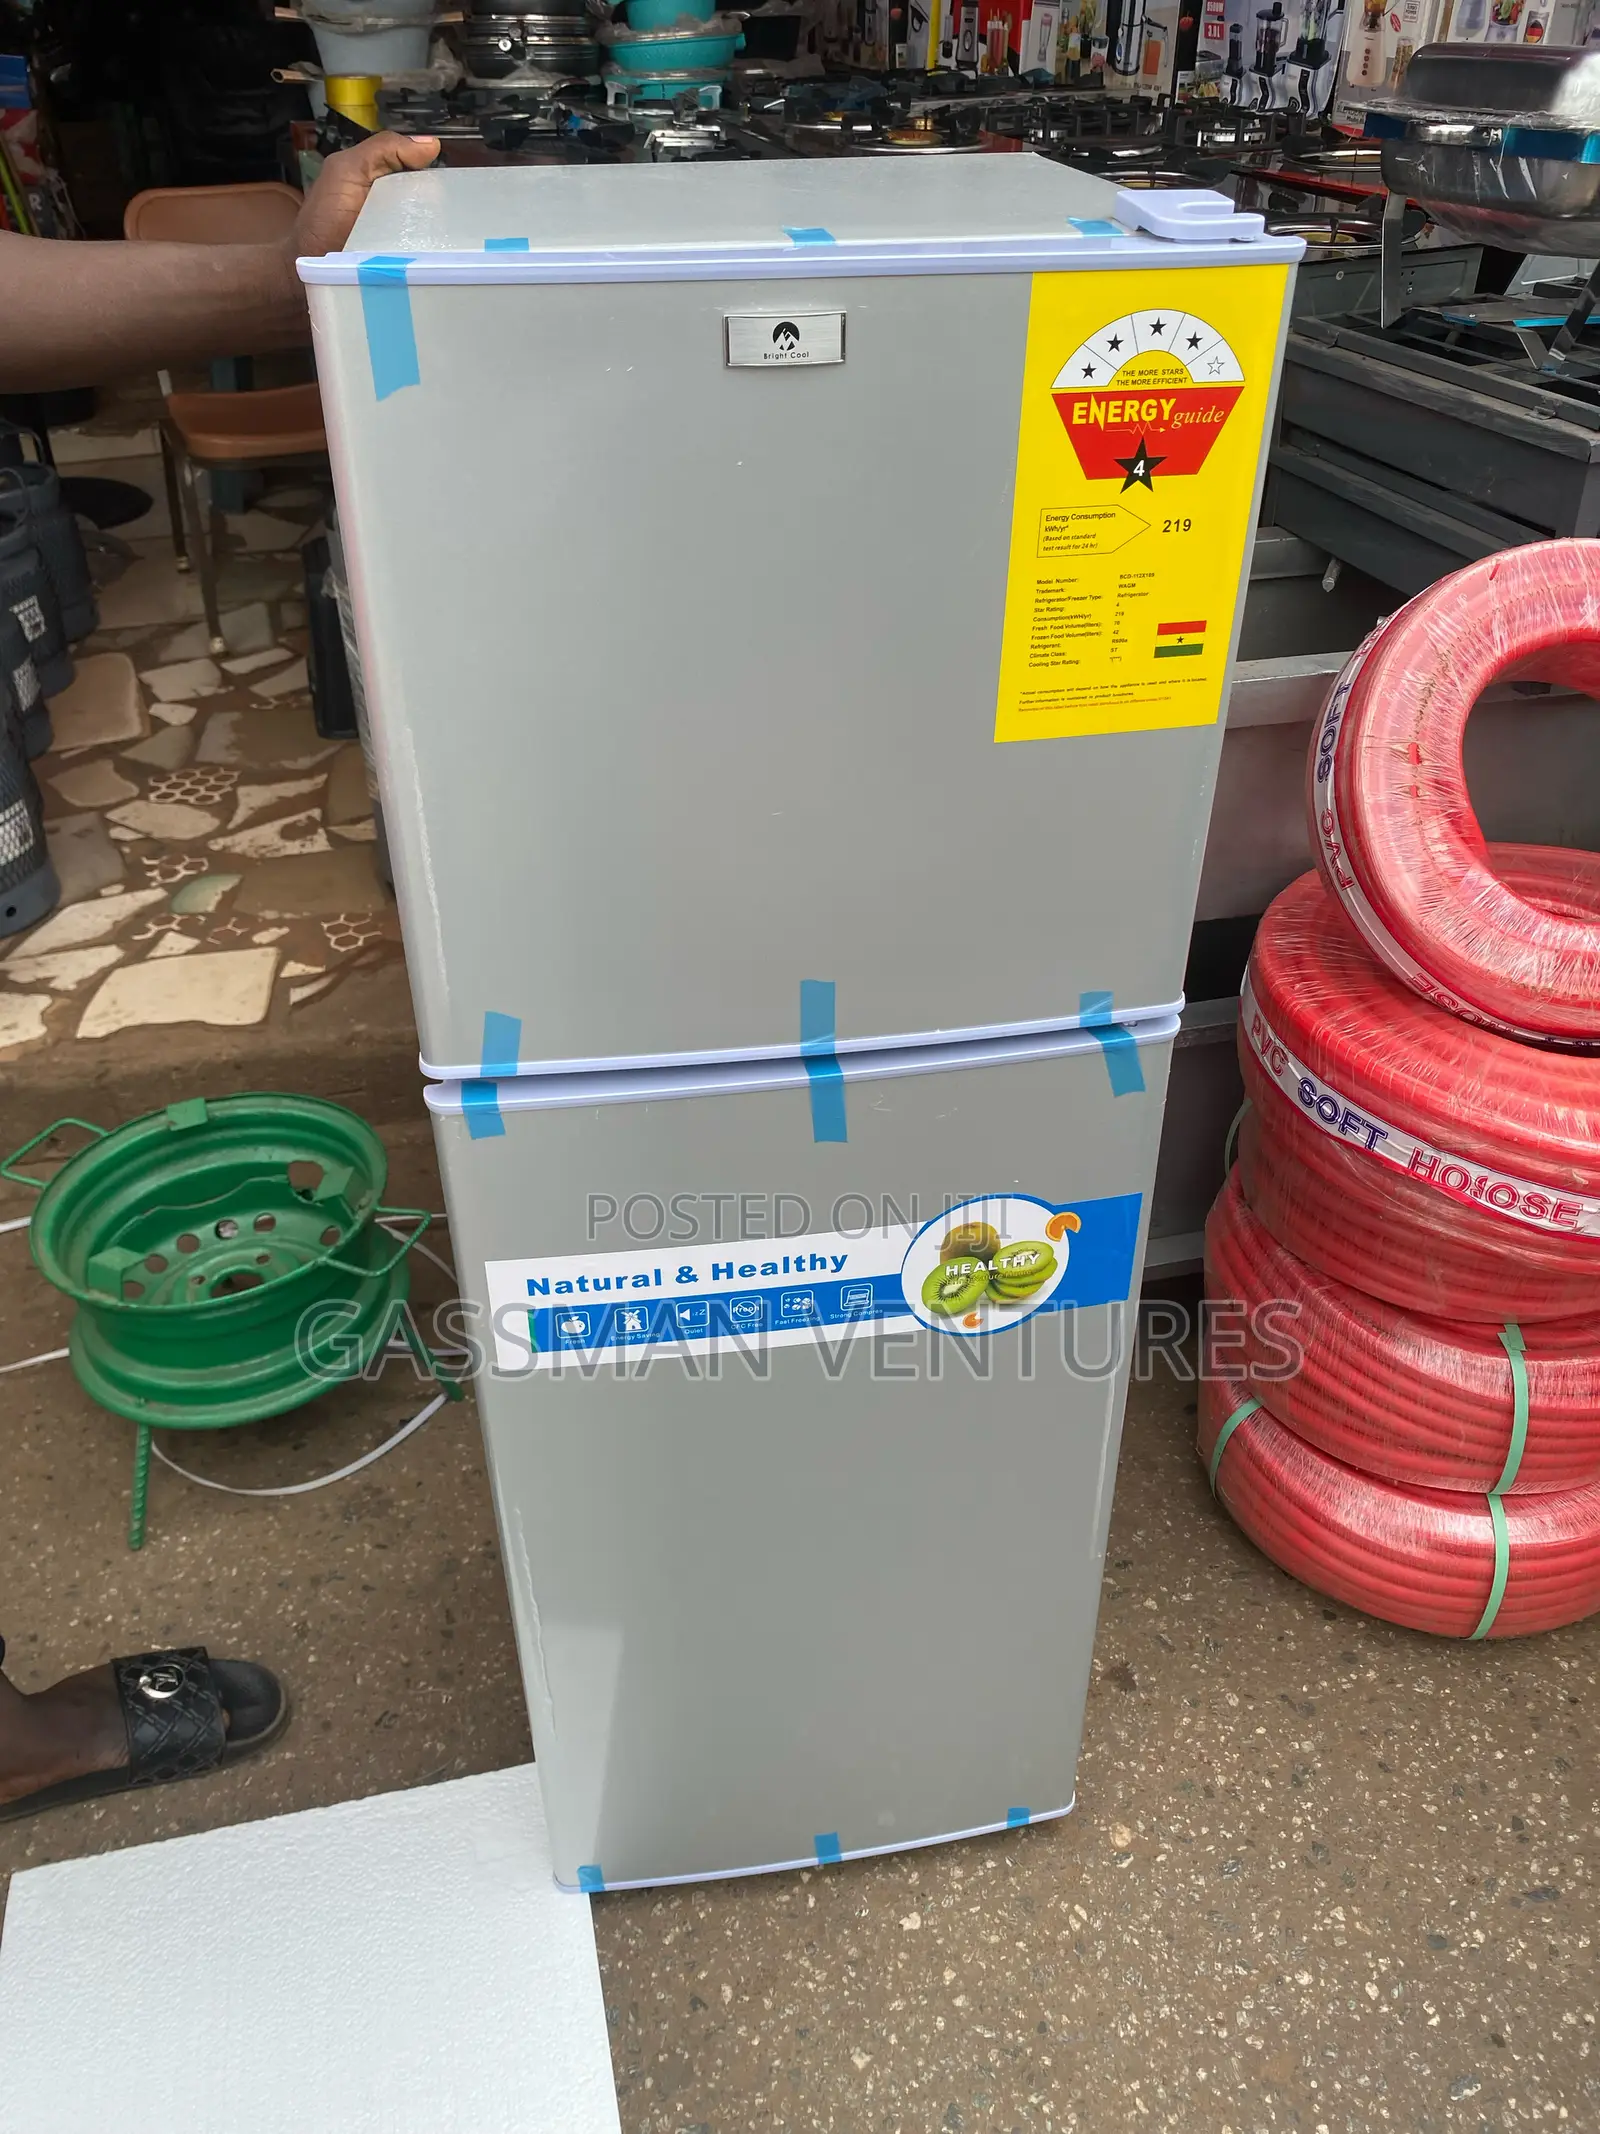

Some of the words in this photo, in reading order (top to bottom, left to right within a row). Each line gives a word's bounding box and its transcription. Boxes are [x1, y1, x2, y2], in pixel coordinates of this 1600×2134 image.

[763, 352, 788, 360] Bright
[790, 351, 810, 359] Cool
[1116, 378, 1130, 386] THE
[1130, 378, 1152, 386] MORE
[1152, 376, 1188, 386] EFFICIENT
[1122, 369, 1136, 377] THE
[1138, 368, 1159, 376] MORE
[1161, 368, 1184, 376] STARS
[1072, 394, 1177, 432] ENERGY
[1171, 405, 1225, 429] guide
[1133, 460, 1146, 477] 4
[1045, 514, 1070, 522] Energy
[1070, 512, 1116, 520] Consumption
[1162, 518, 1192, 533] 219
[1316, 680, 1352, 784] SOFT
[1319, 806, 1356, 893] PVC
[1251, 1011, 1288, 1078] PVC
[1297, 1076, 1389, 1152] SOFT
[526, 1268, 662, 1297] Natural
[675, 1266, 699, 1284] &
[712, 1253, 848, 1281] Healthy
[945, 1253, 1041, 1276] HEALTHY
[610, 1334, 636, 1342] Energy
[790, 1316, 821, 1324] Freezing
